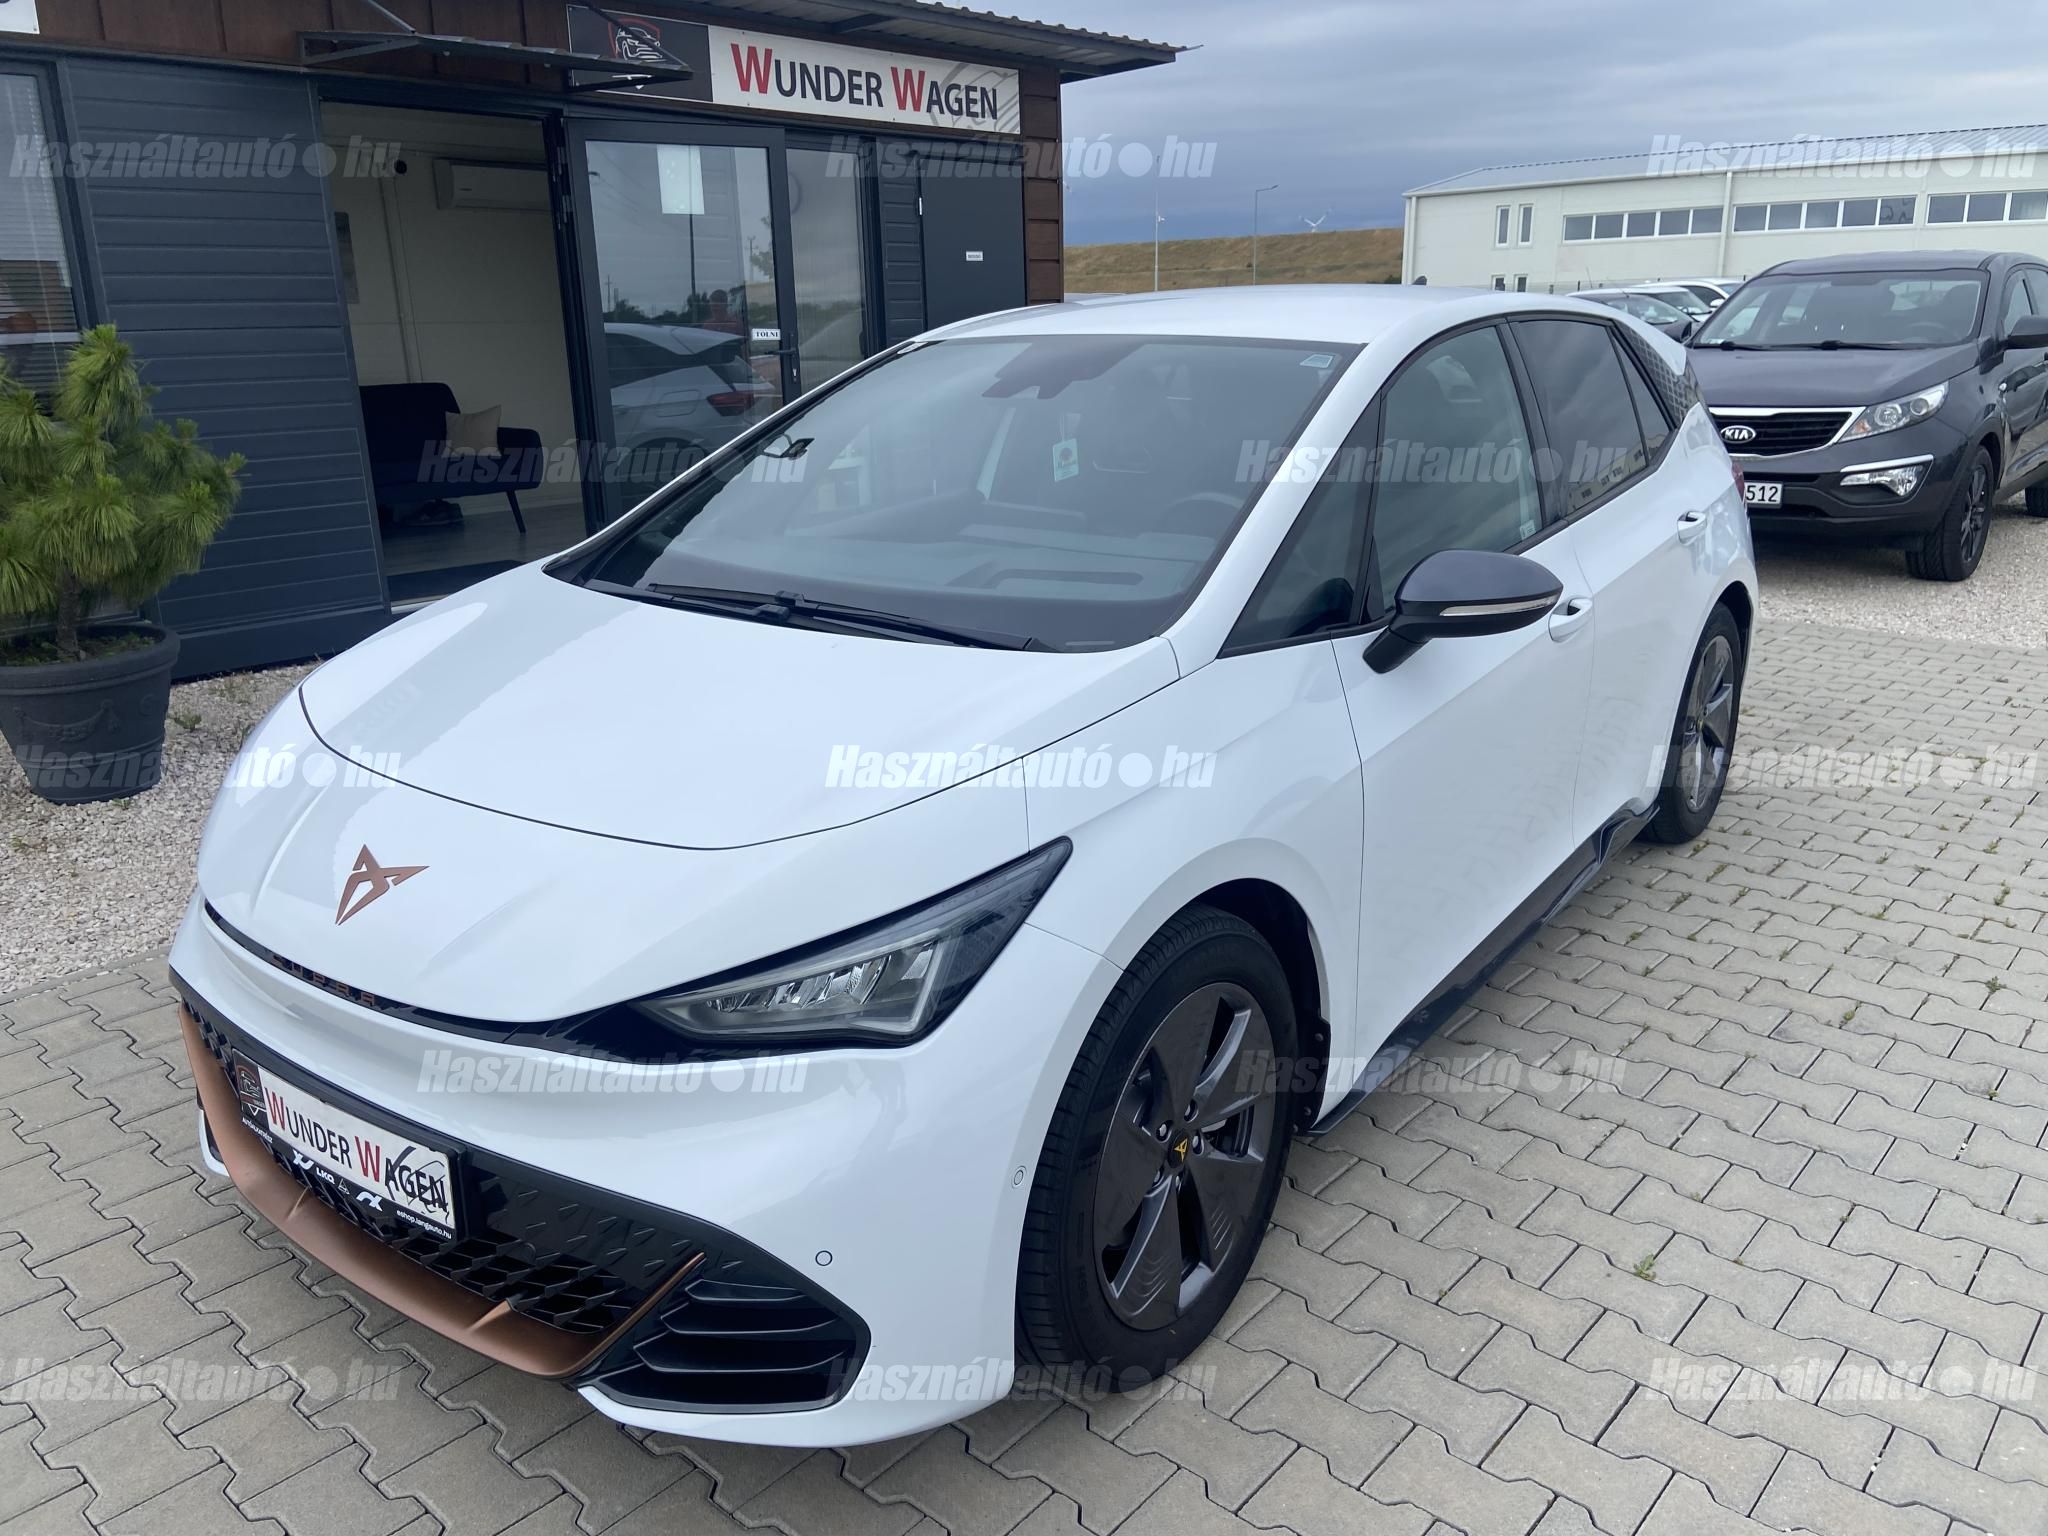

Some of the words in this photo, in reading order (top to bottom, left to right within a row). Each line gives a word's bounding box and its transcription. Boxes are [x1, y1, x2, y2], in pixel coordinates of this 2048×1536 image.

[730, 43, 883, 107] WUNDER
[891, 66, 998, 120] WAGEN
[1724, 429, 1749, 440] KIA
[263, 1086, 352, 1169] WUNDER
[354, 1136, 449, 1212] WAGEN
